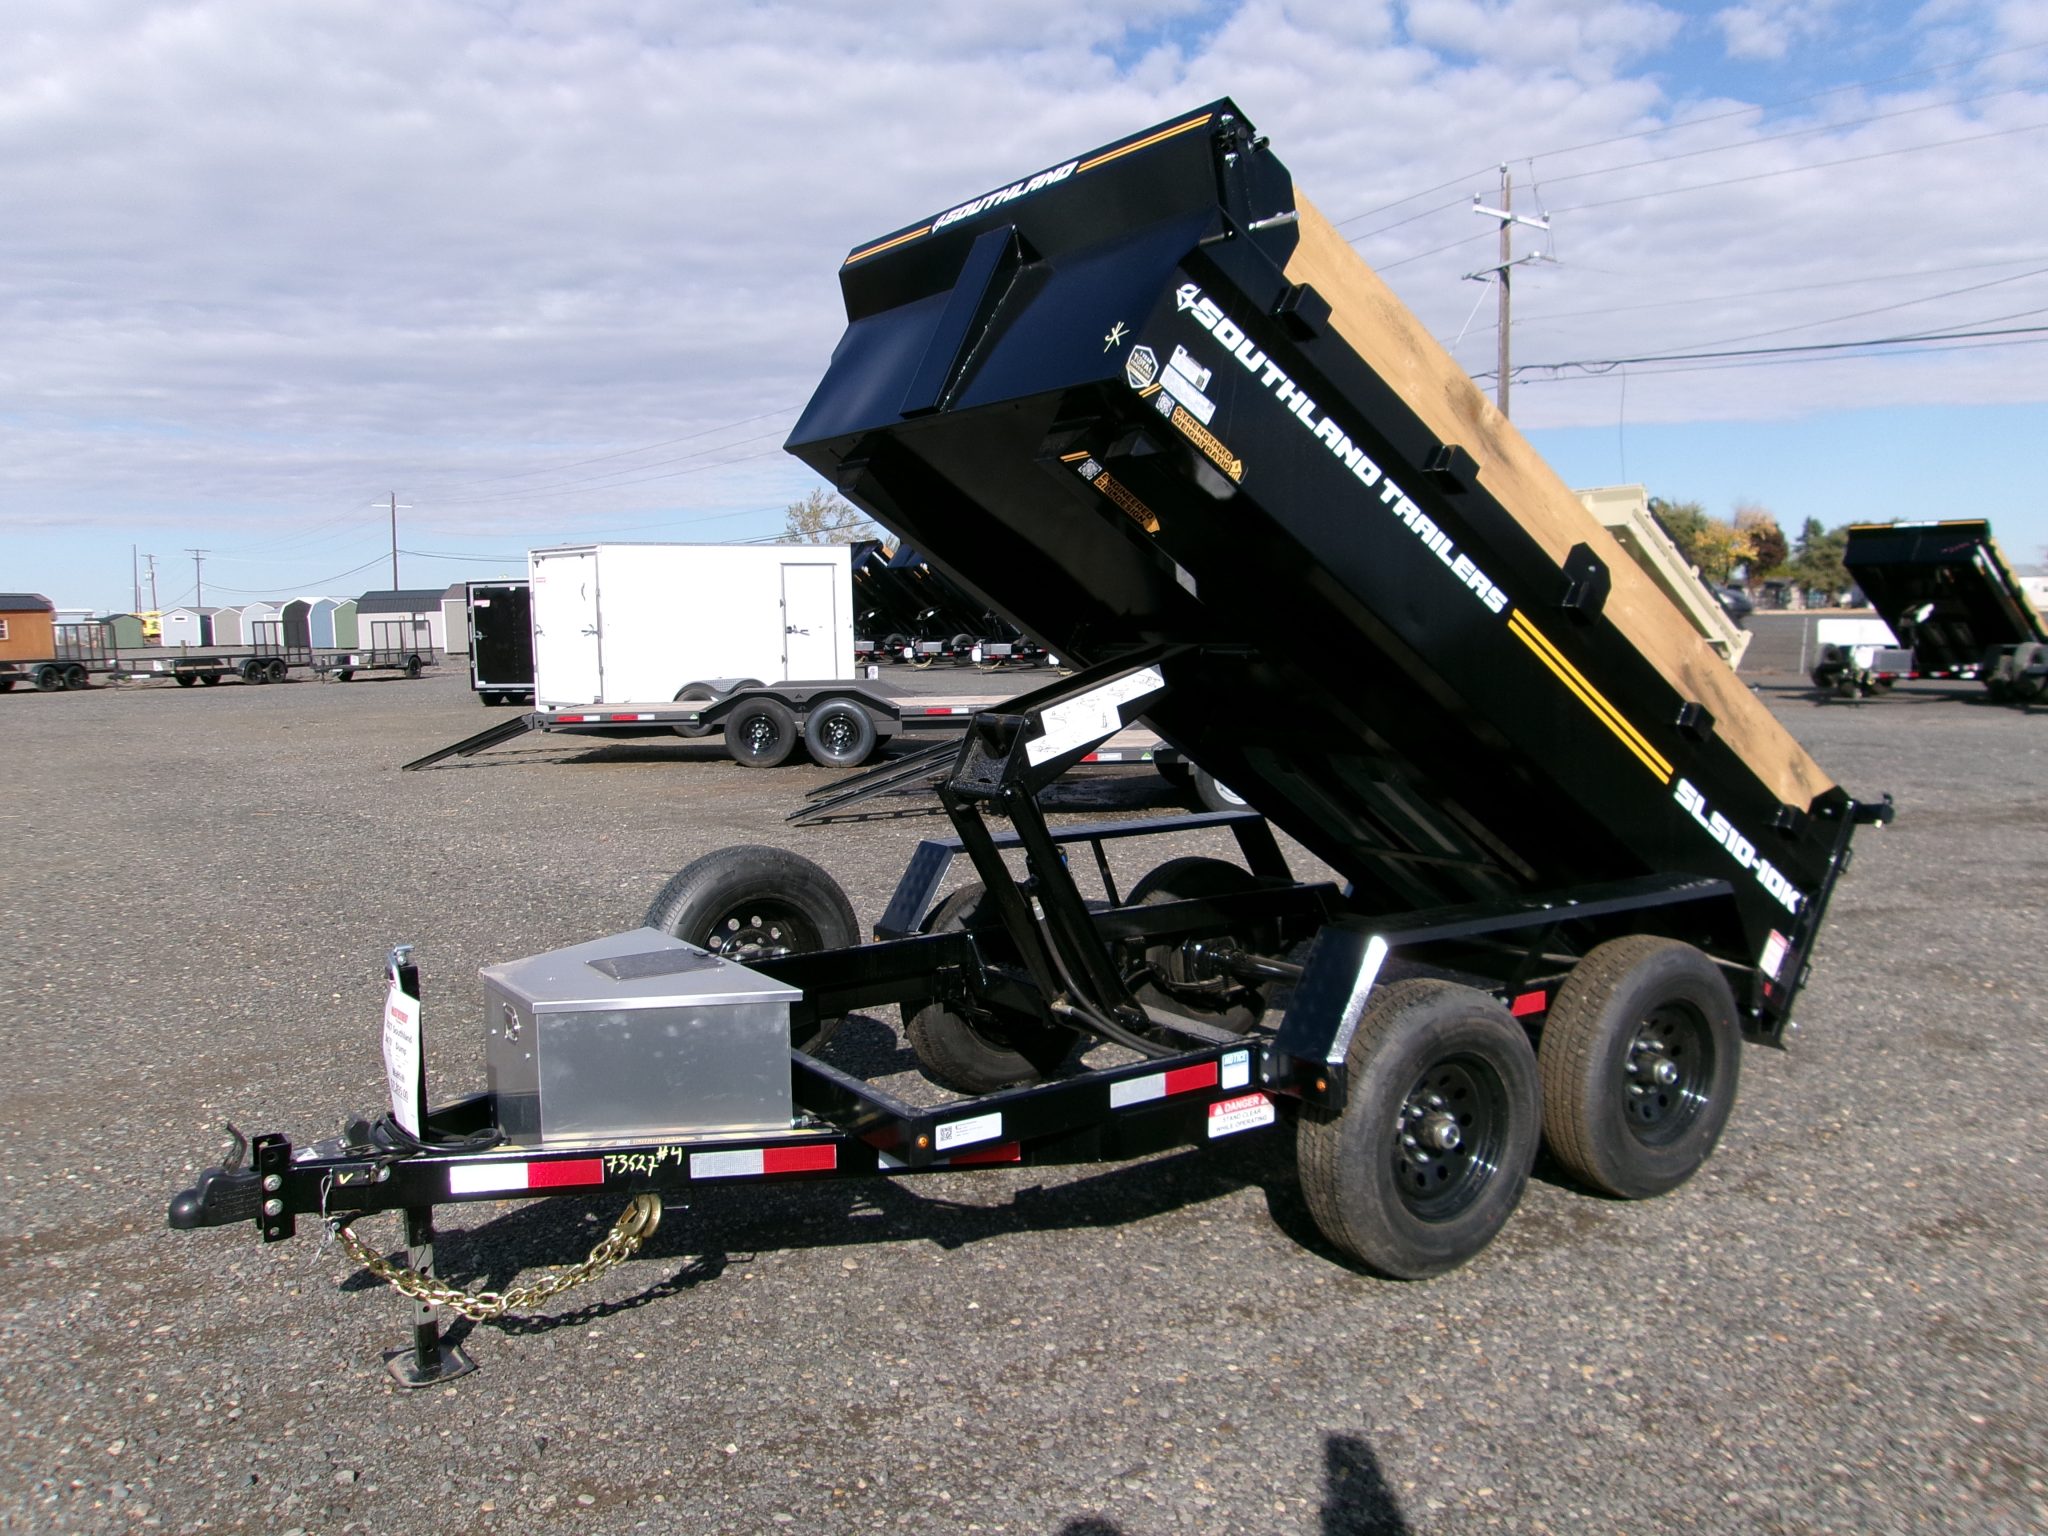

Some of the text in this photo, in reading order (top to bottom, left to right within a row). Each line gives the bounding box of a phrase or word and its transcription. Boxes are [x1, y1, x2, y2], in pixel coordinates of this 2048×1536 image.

[941, 161, 1079, 227] SOUTHLAND
[1132, 353, 1154, 373] TOTAL
[1172, 415, 1231, 470] WEIGHT RATIO
[1174, 407, 1221, 451] STRENGTH
[1191, 297, 1508, 614] SOUTHLAND TRAILERS
[1100, 473, 1154, 520] ENGINEERED
[1113, 494, 1146, 523] DESIGN
[1673, 778, 1801, 914] SLS10-10K
[1225, 1096, 1259, 1112] DANGER
[1243, 1108, 1261, 1118] CLEAR
